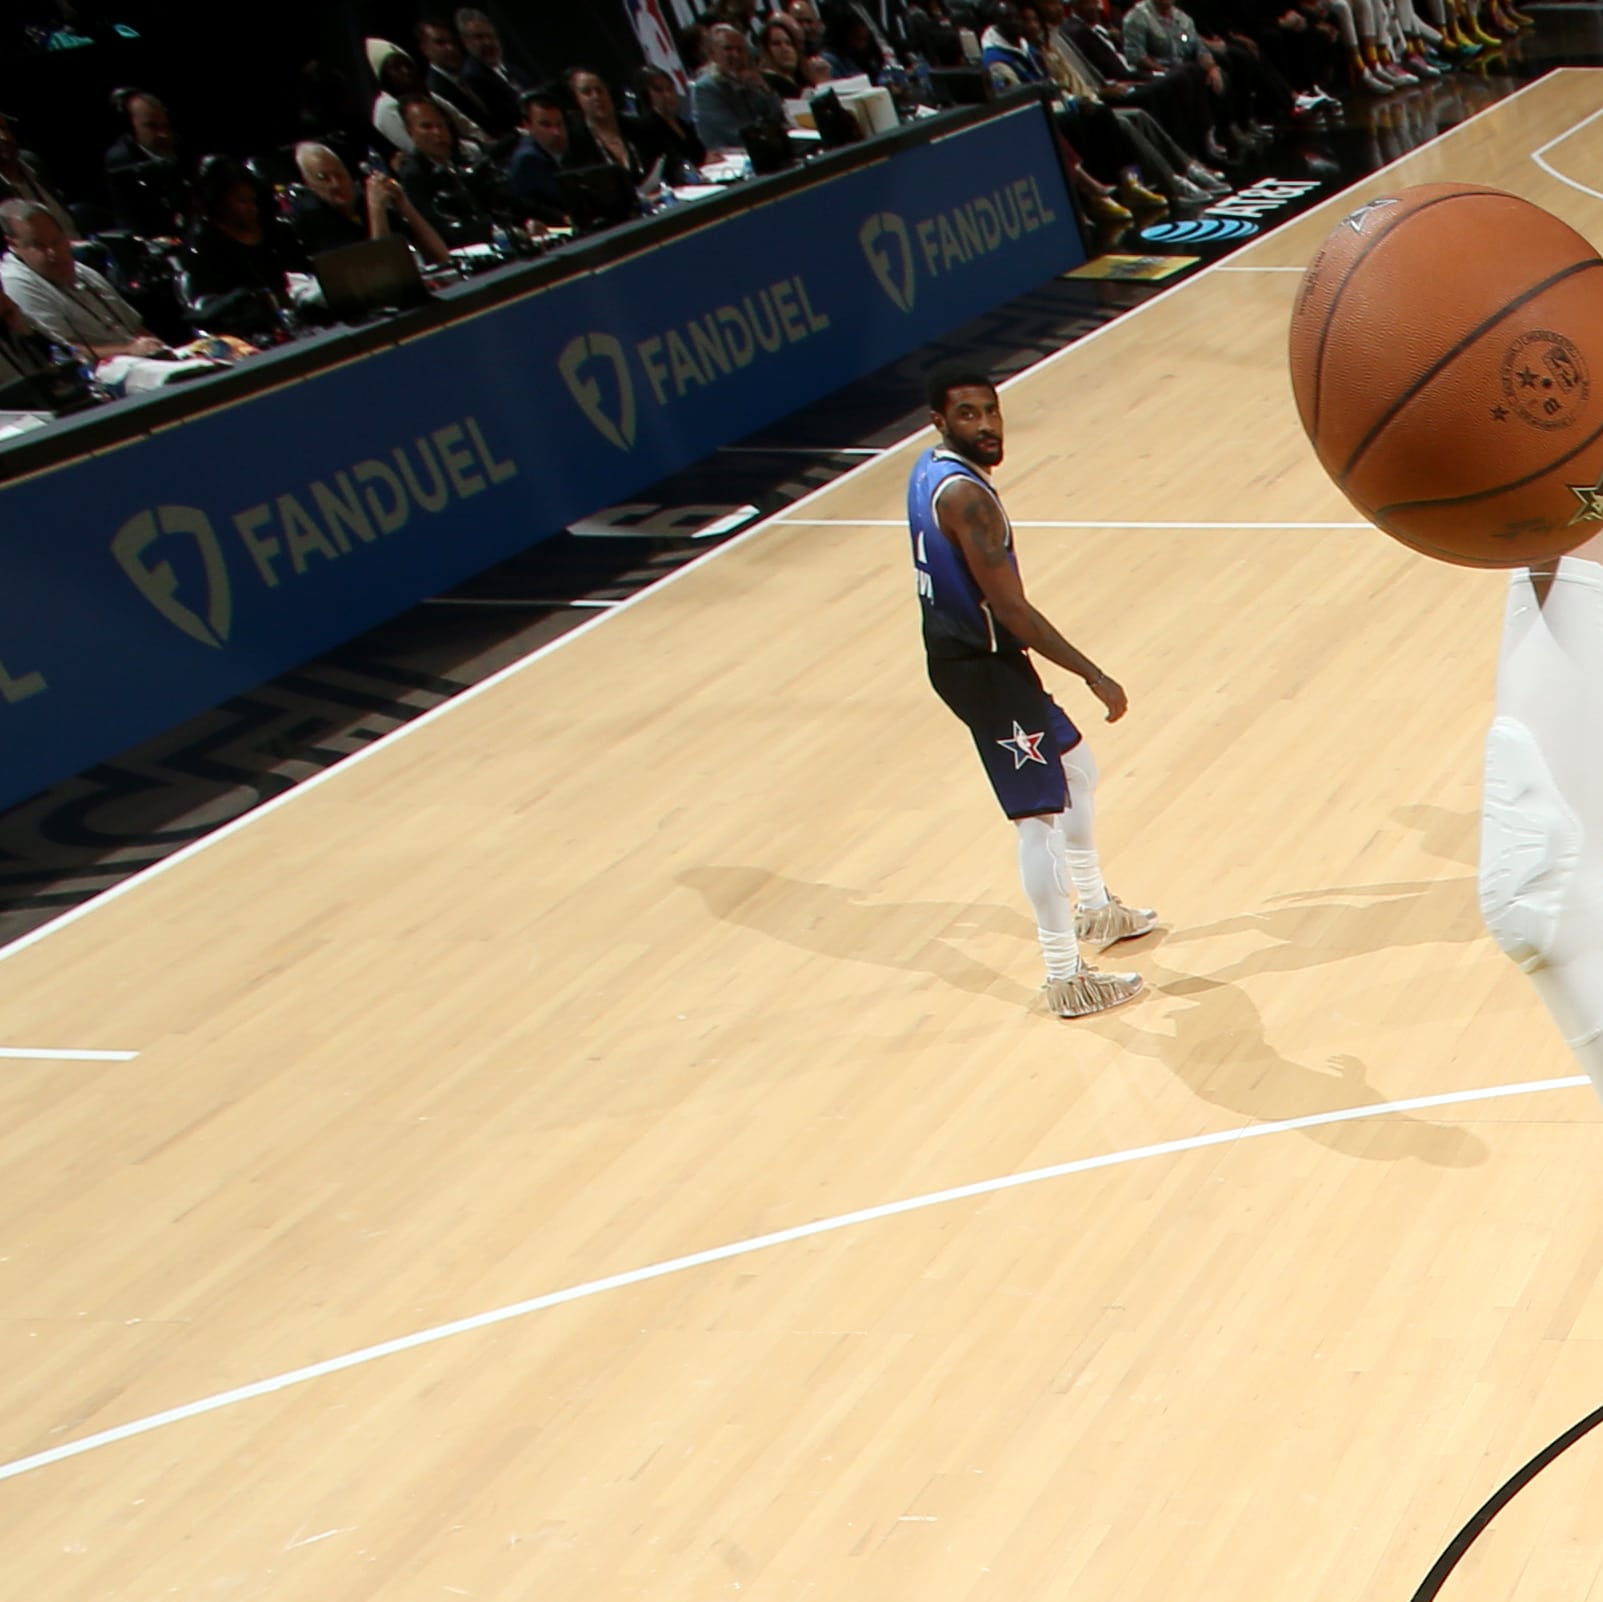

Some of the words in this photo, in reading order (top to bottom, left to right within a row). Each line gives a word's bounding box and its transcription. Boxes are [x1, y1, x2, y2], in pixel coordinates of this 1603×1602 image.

[916, 176, 1055, 279] FANDUEL
[1204, 177, 1322, 218] AT&T
[640, 276, 830, 406] FANDUEL
[233, 417, 518, 588] FANDUEL
